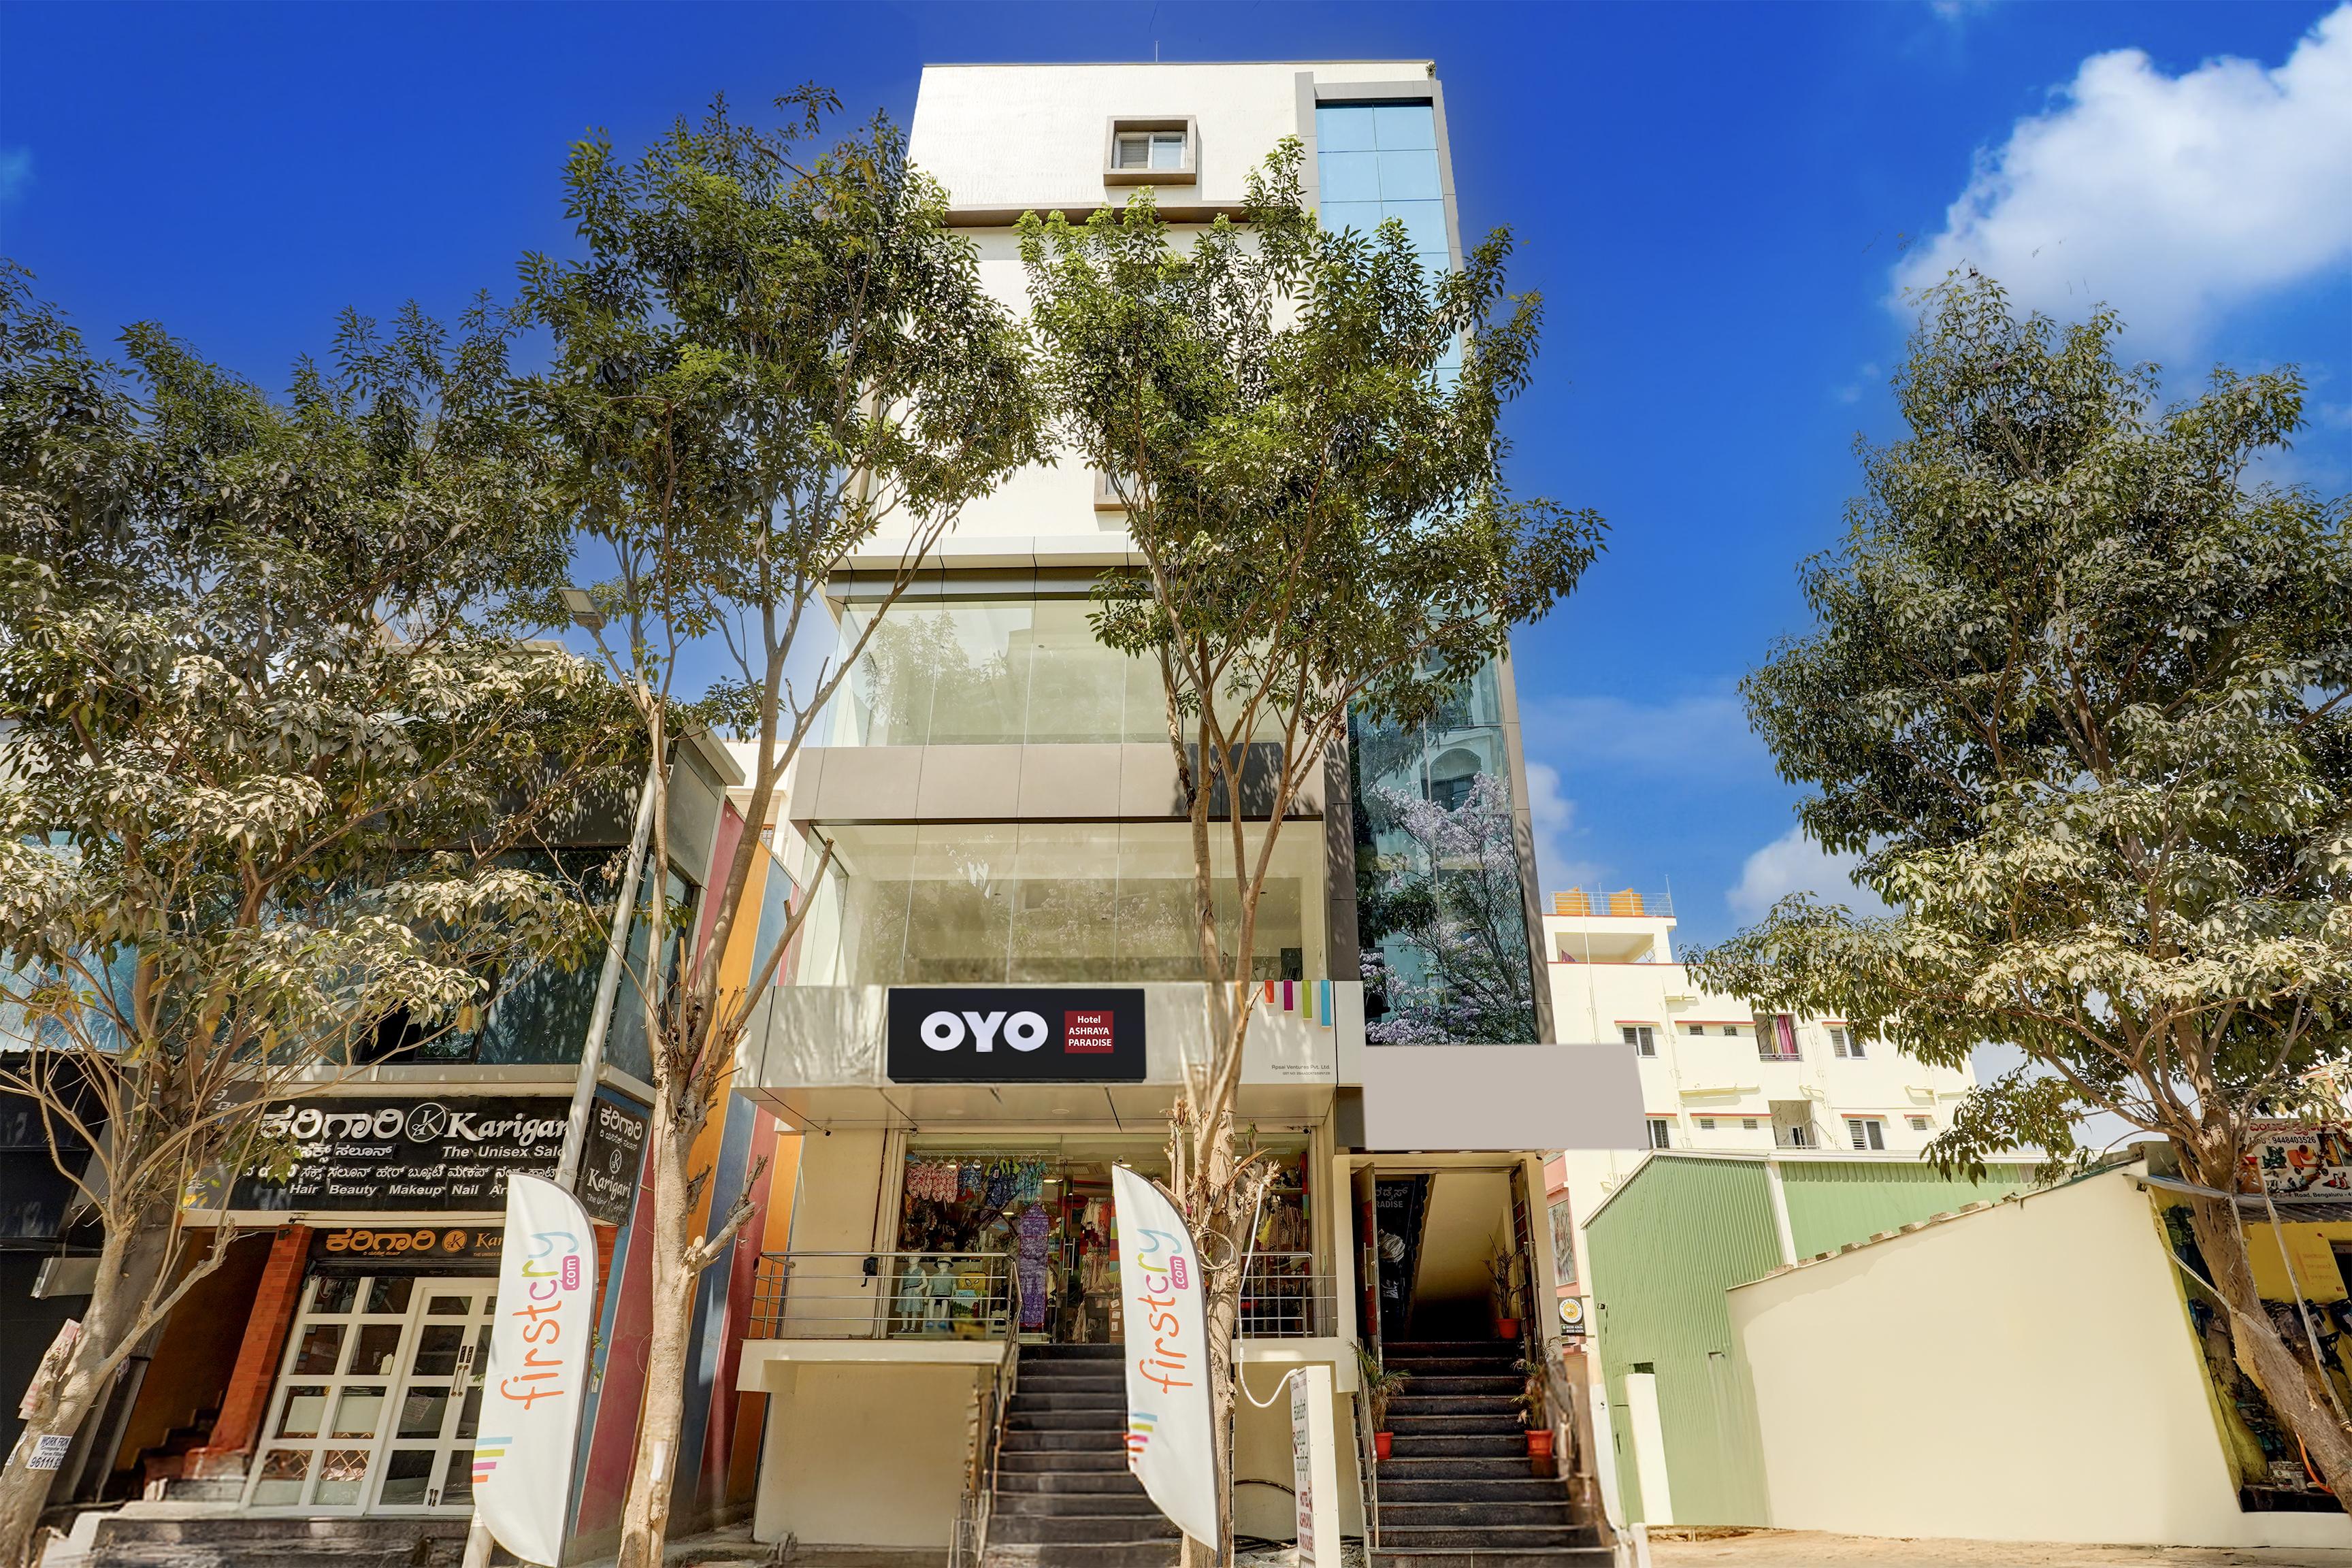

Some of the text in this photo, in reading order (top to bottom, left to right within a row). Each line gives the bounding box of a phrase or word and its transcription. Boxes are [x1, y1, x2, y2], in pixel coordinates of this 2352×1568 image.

[1077, 1015, 1101, 1024] Hotel
[921, 1011, 1049, 1053] OYO
[1068, 1027, 1109, 1035] ASHRAYA
[1068, 1039, 1112, 1047] PARADISE
[444, 1113, 569, 1147] Karigar
[2272, 1136, 2316, 1144] 9448403526
[443, 1146, 470, 1158] The
[478, 1146, 529, 1158] Unisex
[289, 1184, 508, 1197] Hair Beauty Makeup Nail Ar
[587, 1167, 632, 1200] Karigari
[325, 1228, 436, 1251] ಕರಿಗಾರಿ
[1137, 1228, 1193, 1394] firstcry
[501, 1232, 579, 1410] firstcry
